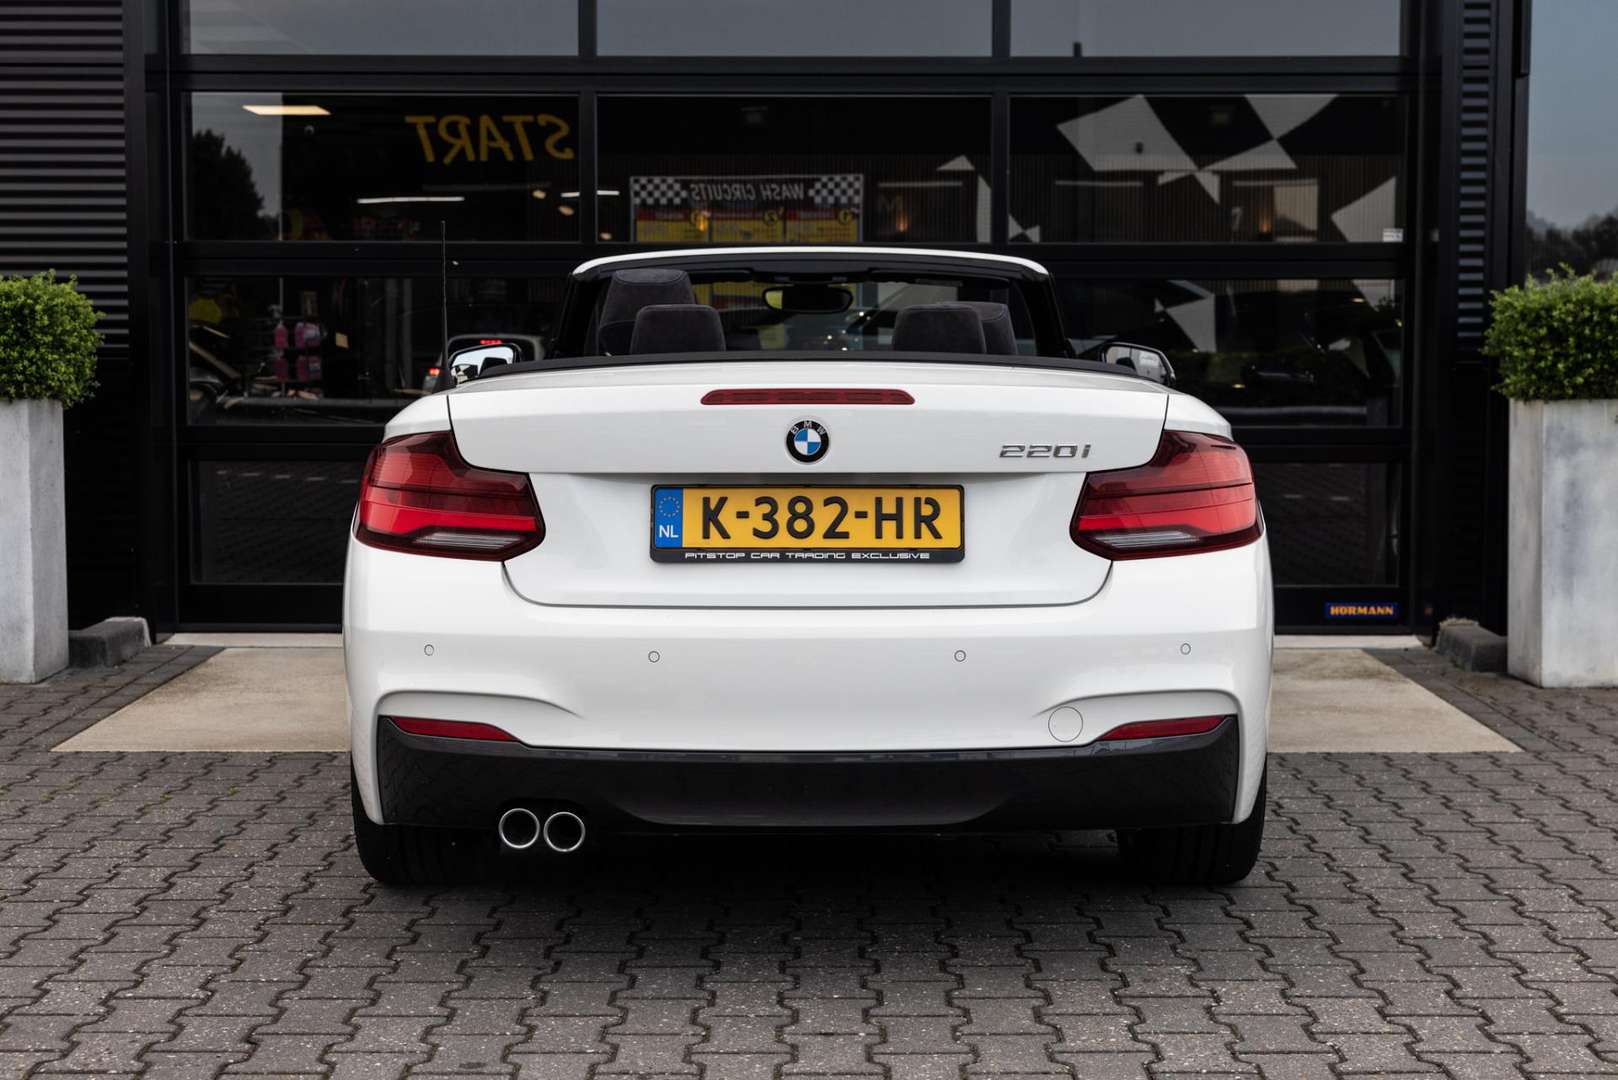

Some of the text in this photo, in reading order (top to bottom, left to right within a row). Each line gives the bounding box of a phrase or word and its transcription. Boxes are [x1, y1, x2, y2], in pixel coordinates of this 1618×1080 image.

[790, 420, 826, 435] BMW
[999, 444, 1091, 458] 220i
[701, 496, 943, 540] K-382-HR
[658, 524, 679, 538] NL
